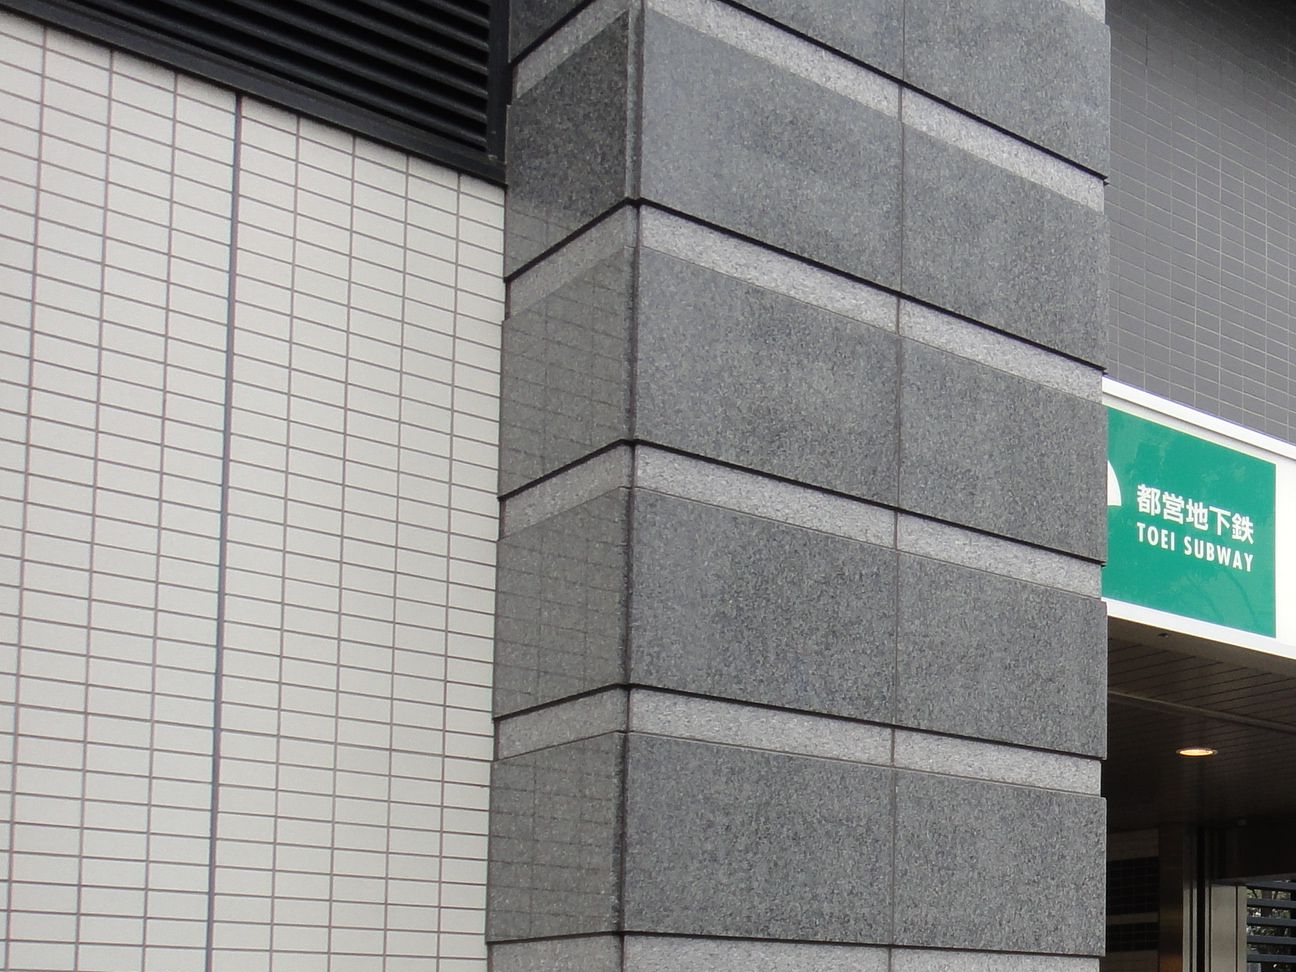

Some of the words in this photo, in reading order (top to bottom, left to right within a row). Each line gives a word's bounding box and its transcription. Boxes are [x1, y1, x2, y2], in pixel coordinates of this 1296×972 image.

[1137, 483, 1254, 545] 都営地下鉄
[1136, 521, 1175, 552] TOEI
[1183, 535, 1254, 572] SUBWAY
